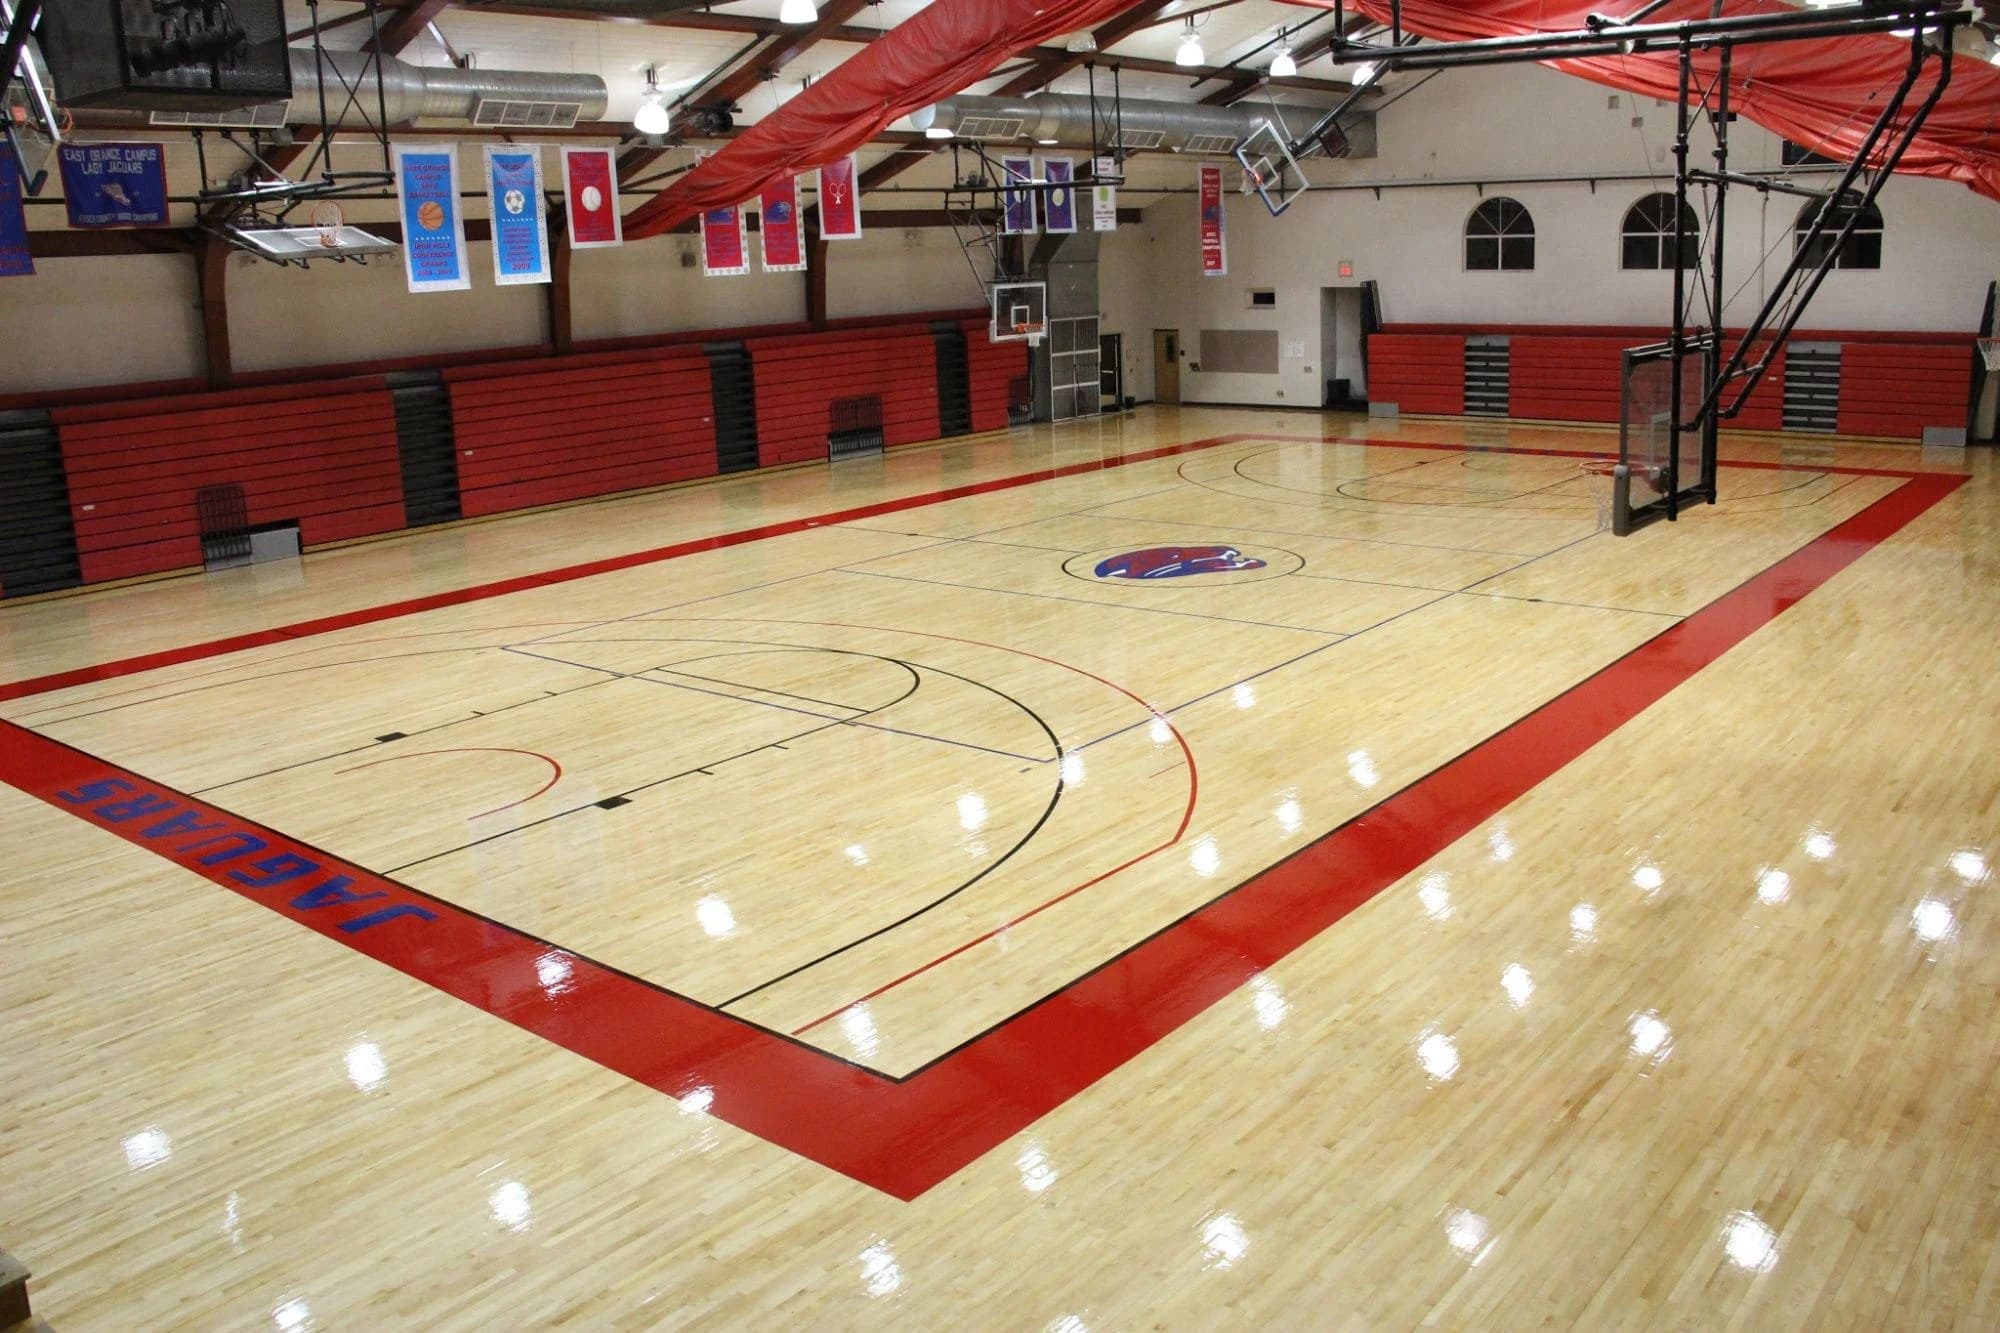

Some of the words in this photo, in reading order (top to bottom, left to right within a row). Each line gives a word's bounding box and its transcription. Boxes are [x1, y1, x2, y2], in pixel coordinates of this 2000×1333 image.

[64, 149, 86, 162] EAST
[89, 148, 121, 162] ORANGE
[124, 148, 158, 161] CAMPUS
[81, 162, 103, 174] LADY
[107, 161, 144, 174] JAGUARS
[55, 777, 439, 935] JAGUARS
